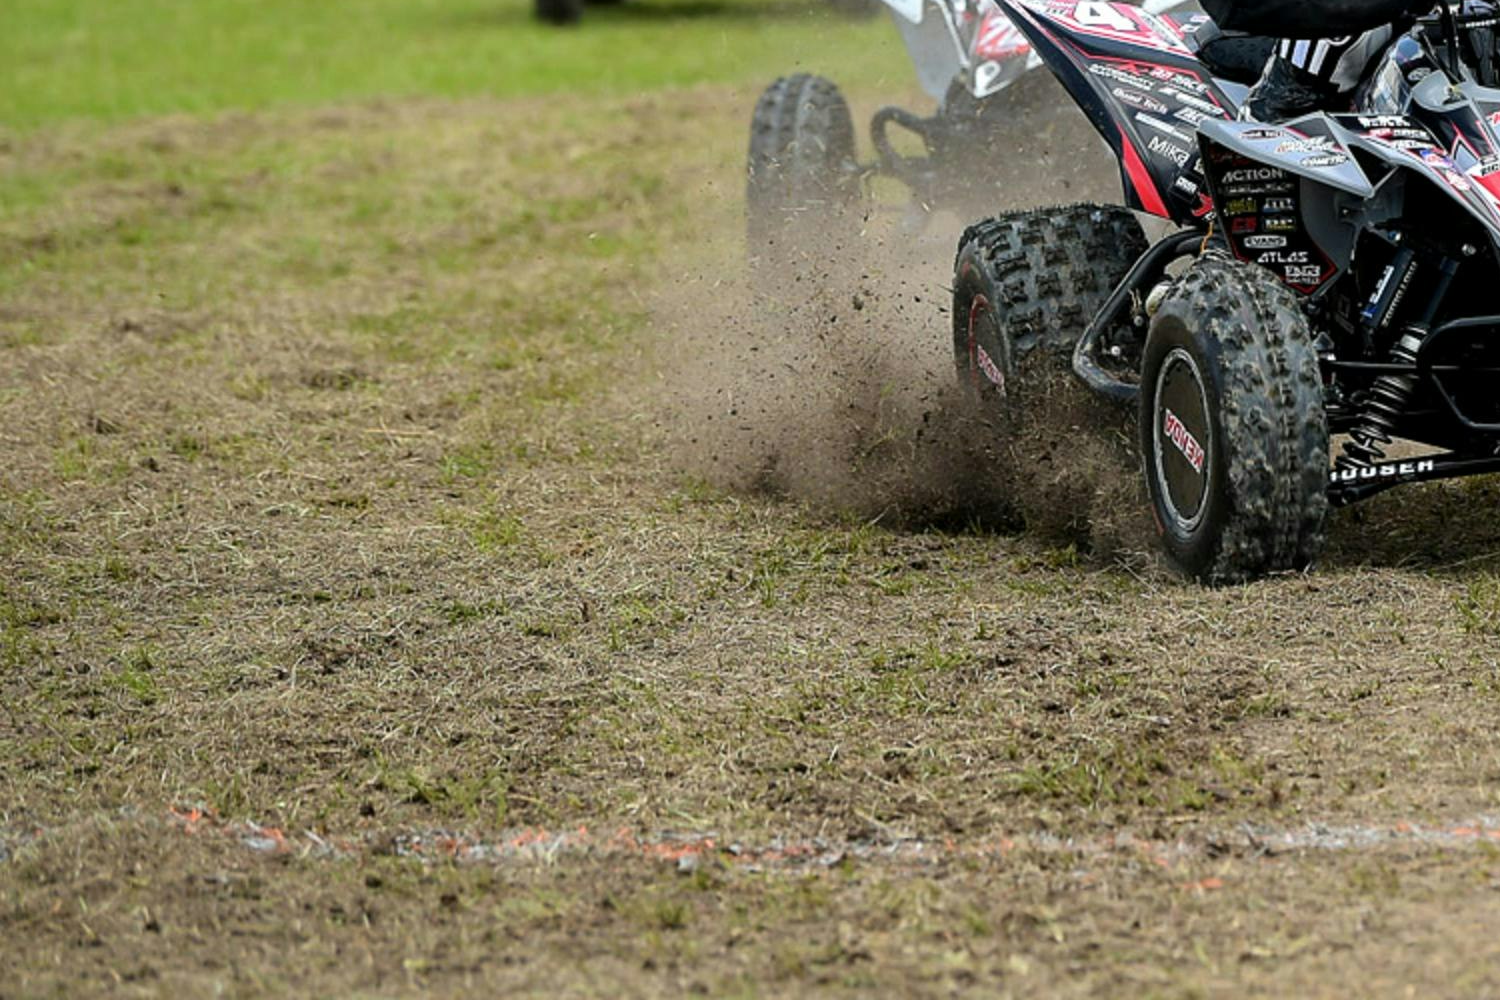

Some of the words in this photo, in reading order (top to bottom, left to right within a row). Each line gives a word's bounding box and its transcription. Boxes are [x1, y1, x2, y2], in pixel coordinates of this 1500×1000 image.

[1074, 0, 1139, 32] 4
[1257, 251, 1309, 263] ATLAS
[1163, 408, 1204, 473] KENDA
